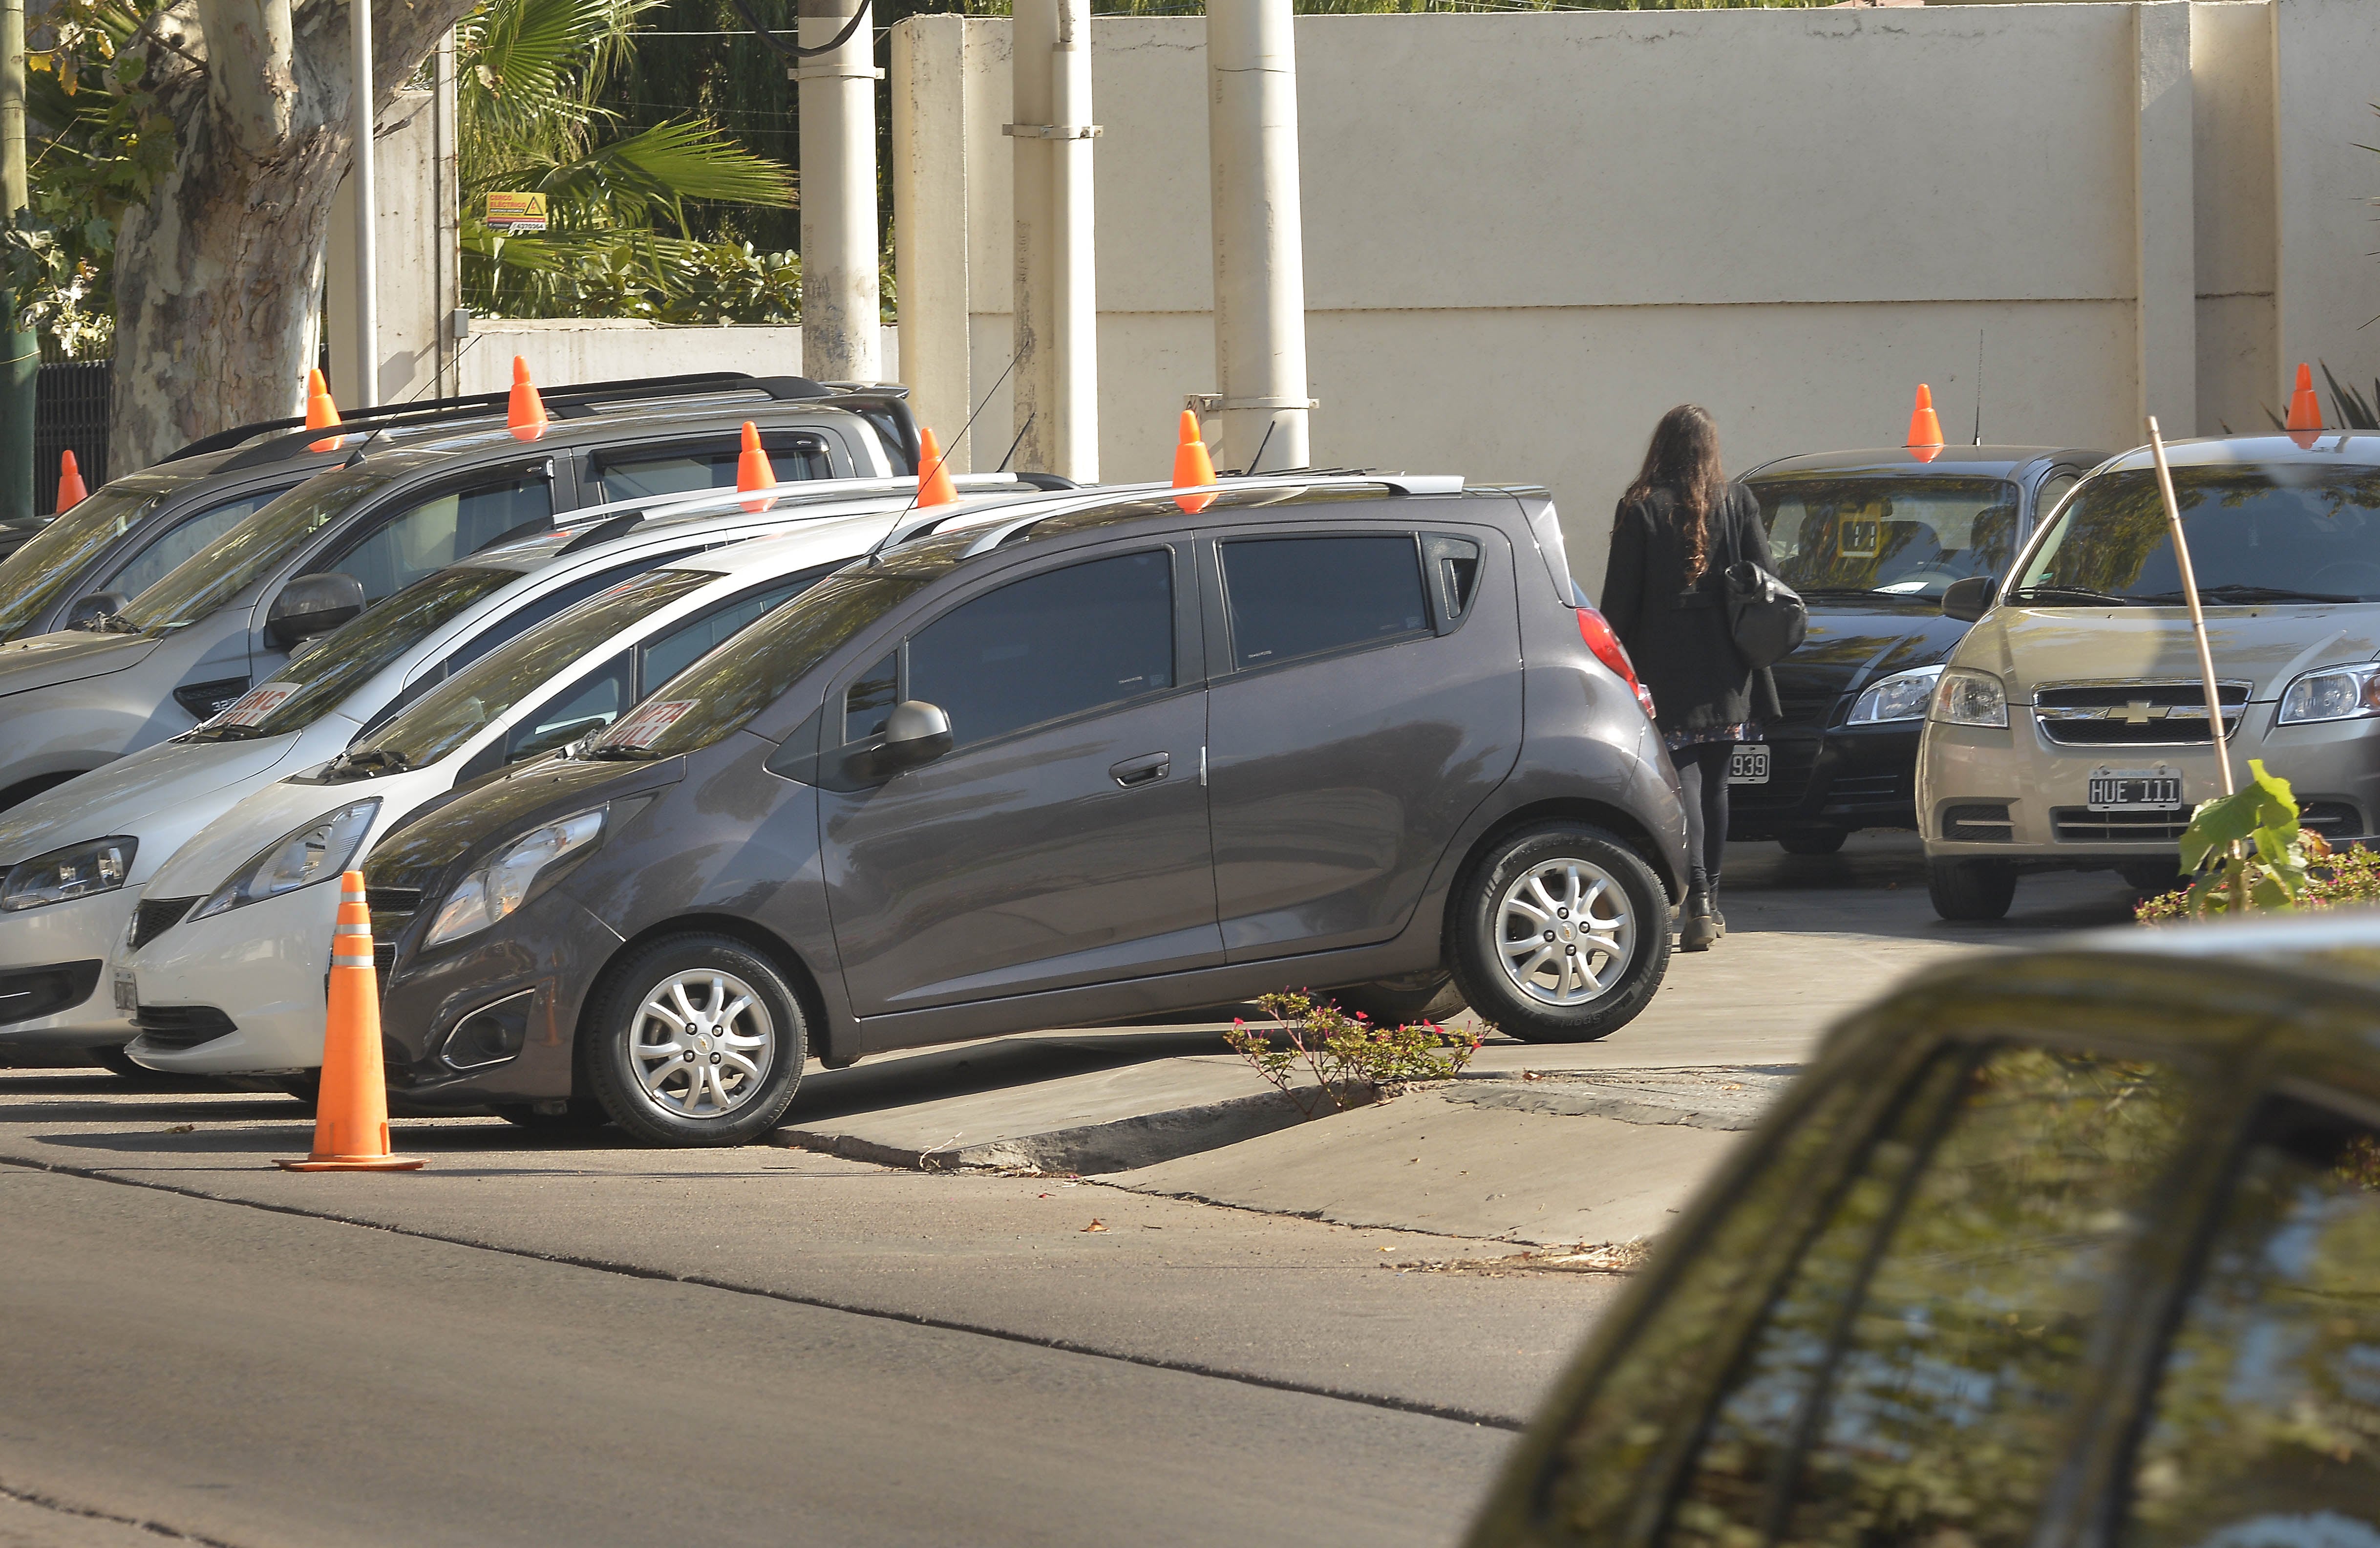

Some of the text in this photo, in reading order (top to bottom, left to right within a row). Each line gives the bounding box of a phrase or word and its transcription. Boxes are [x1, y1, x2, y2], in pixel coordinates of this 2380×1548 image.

[234, 690, 287, 711] GNC
[1732, 755, 1766, 776] 939
[2091, 780, 2177, 802] HUE 111
